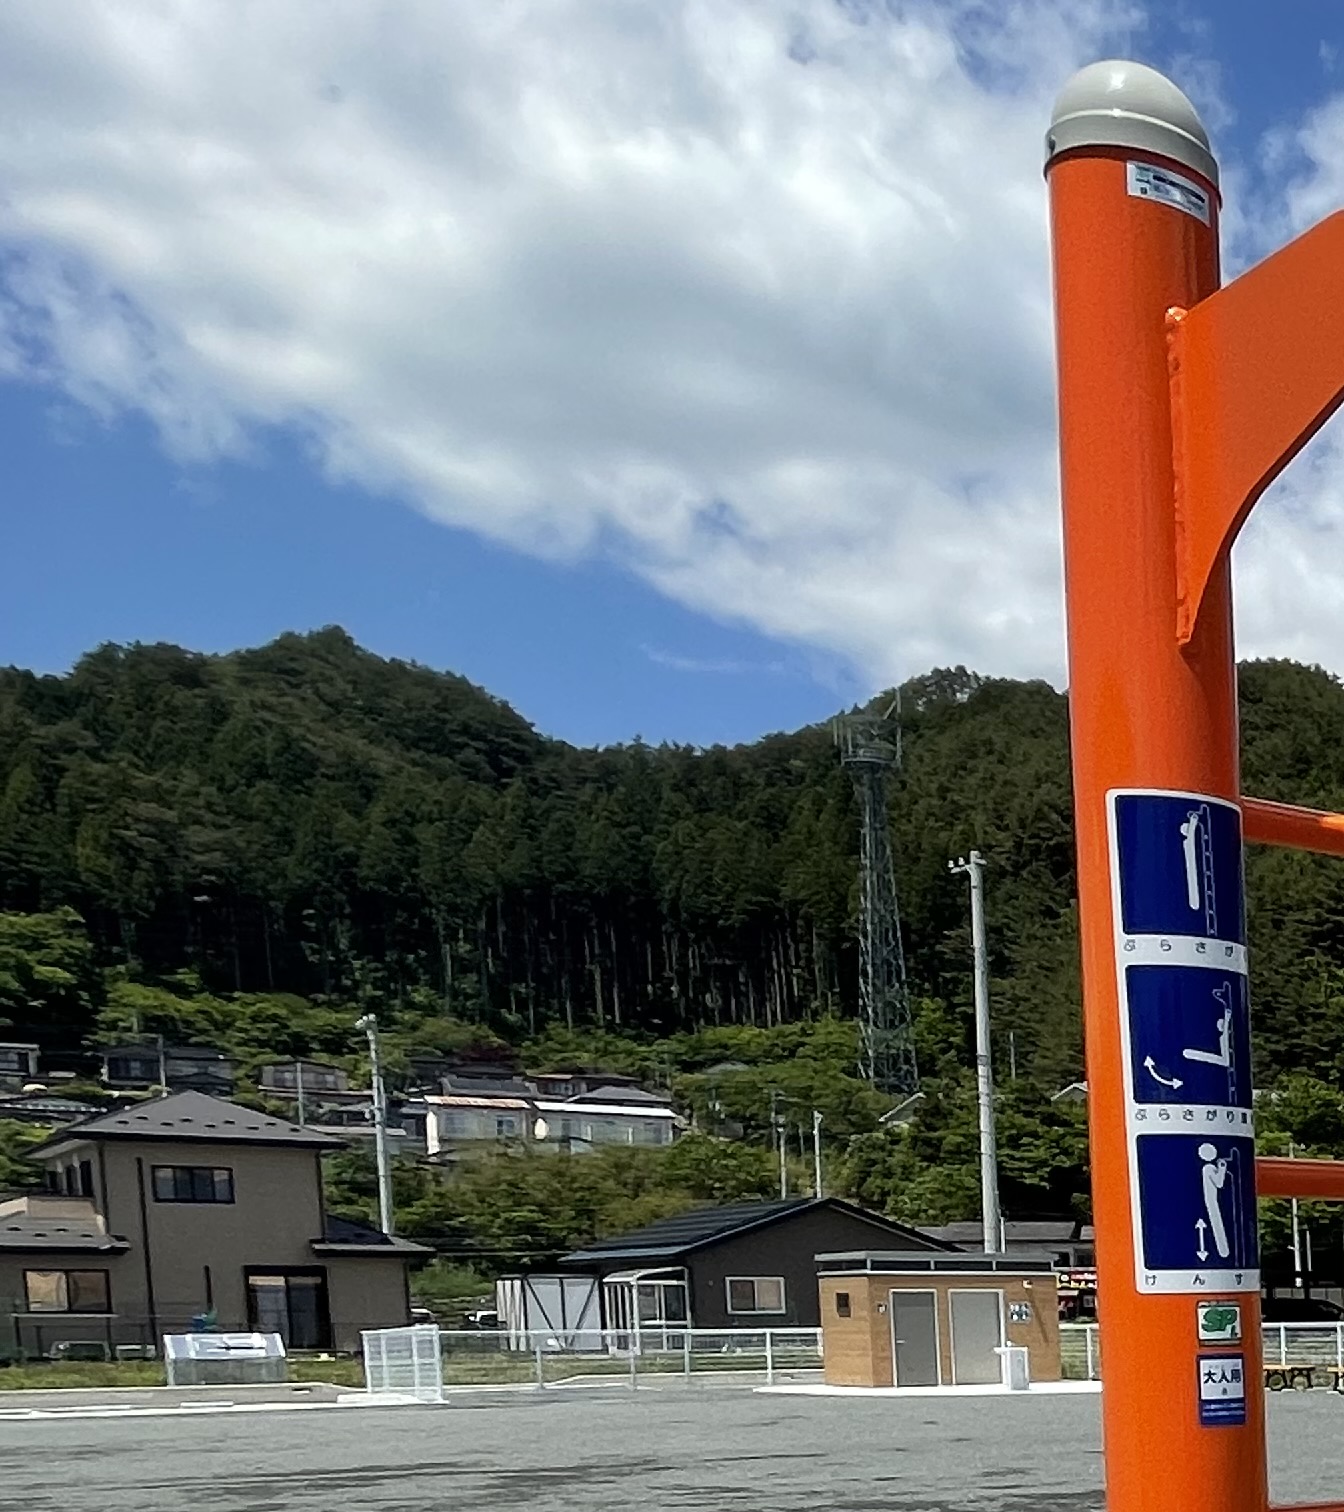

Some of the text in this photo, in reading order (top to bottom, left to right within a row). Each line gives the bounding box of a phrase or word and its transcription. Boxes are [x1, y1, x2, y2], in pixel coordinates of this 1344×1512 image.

[1135, 1108, 1254, 1125] ぶらさがり
